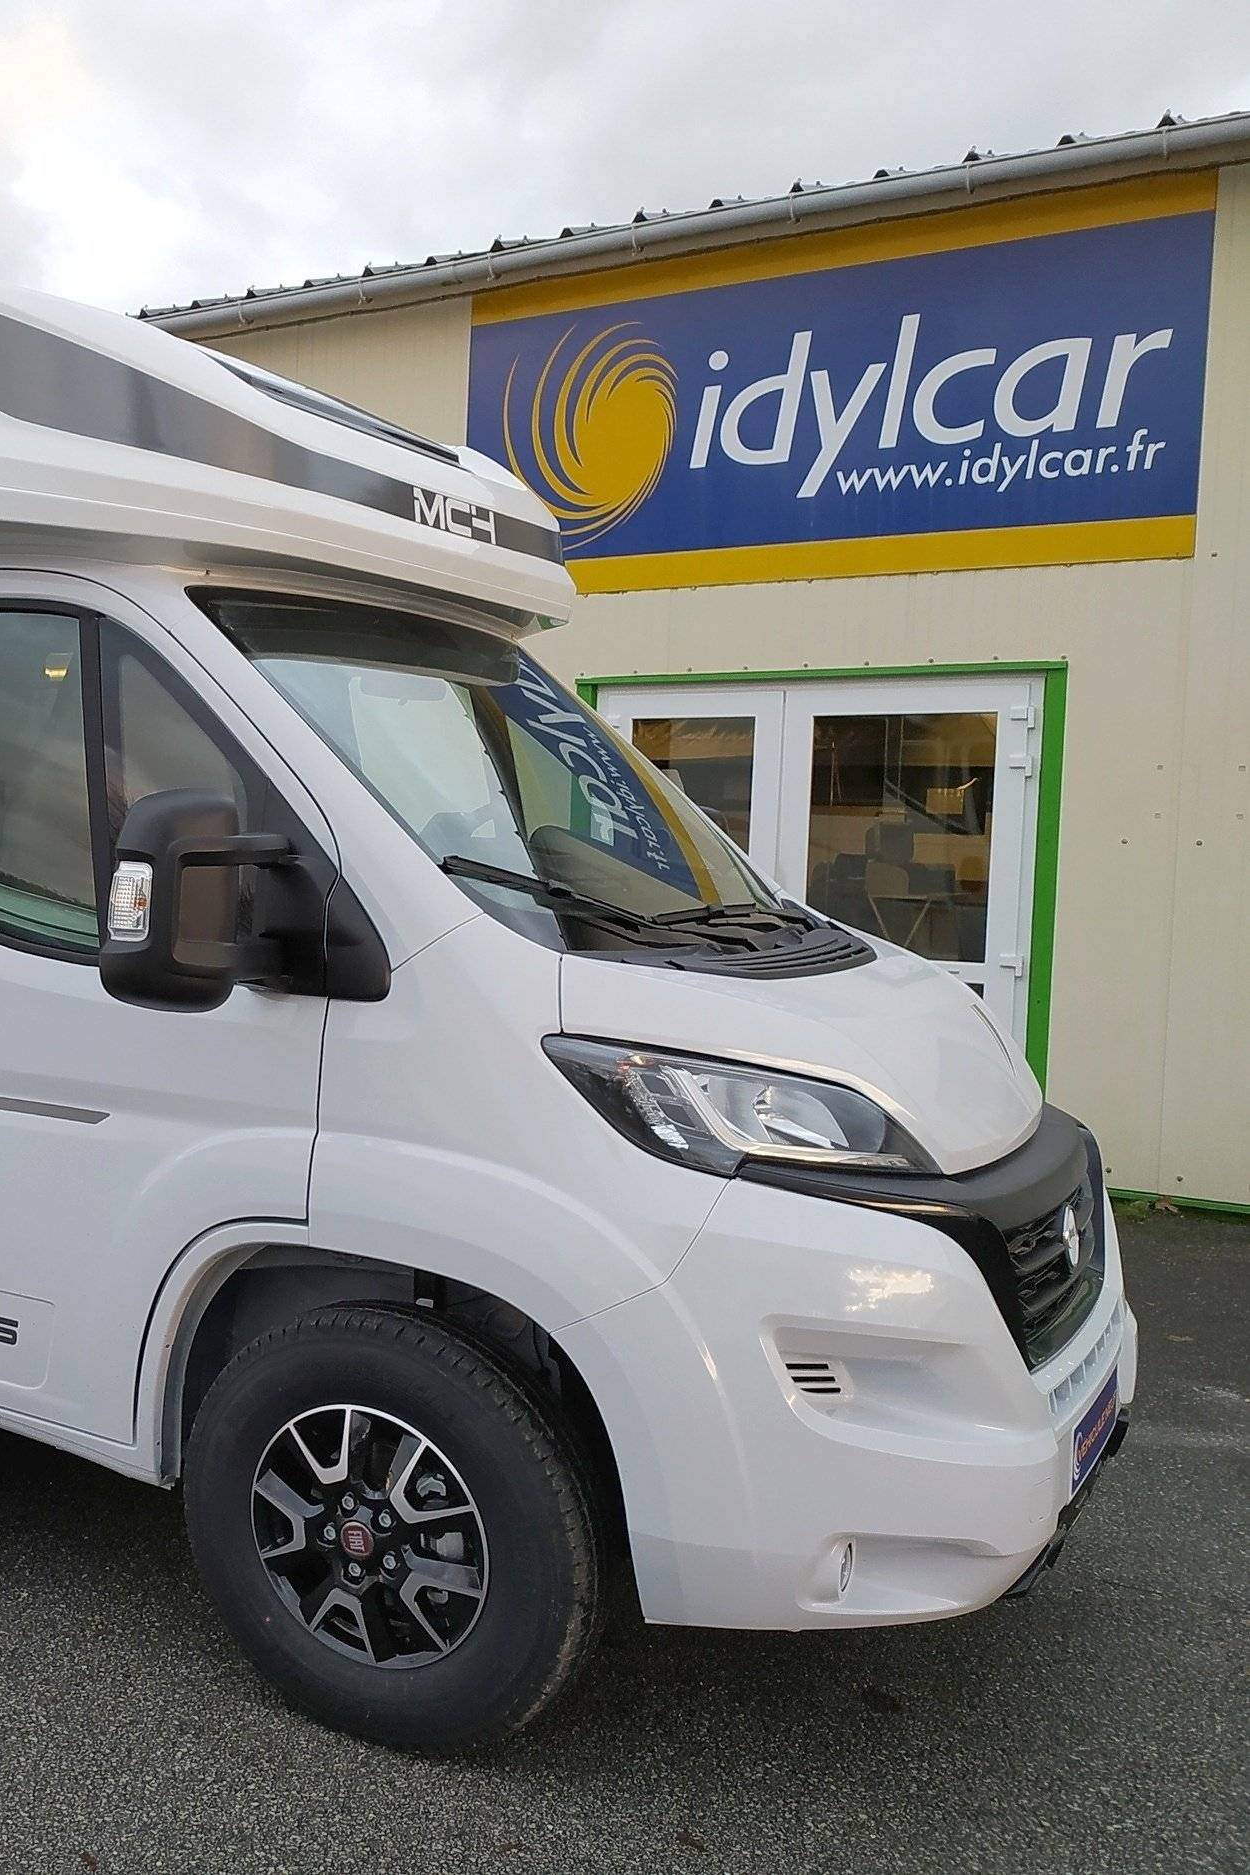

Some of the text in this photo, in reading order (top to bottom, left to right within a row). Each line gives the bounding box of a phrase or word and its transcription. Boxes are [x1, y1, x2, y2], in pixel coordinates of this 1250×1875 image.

[689, 313, 1174, 499] idylcar
[836, 428, 1167, 496] www.idylcar.fr
[347, 1530, 365, 1552] FIAT
